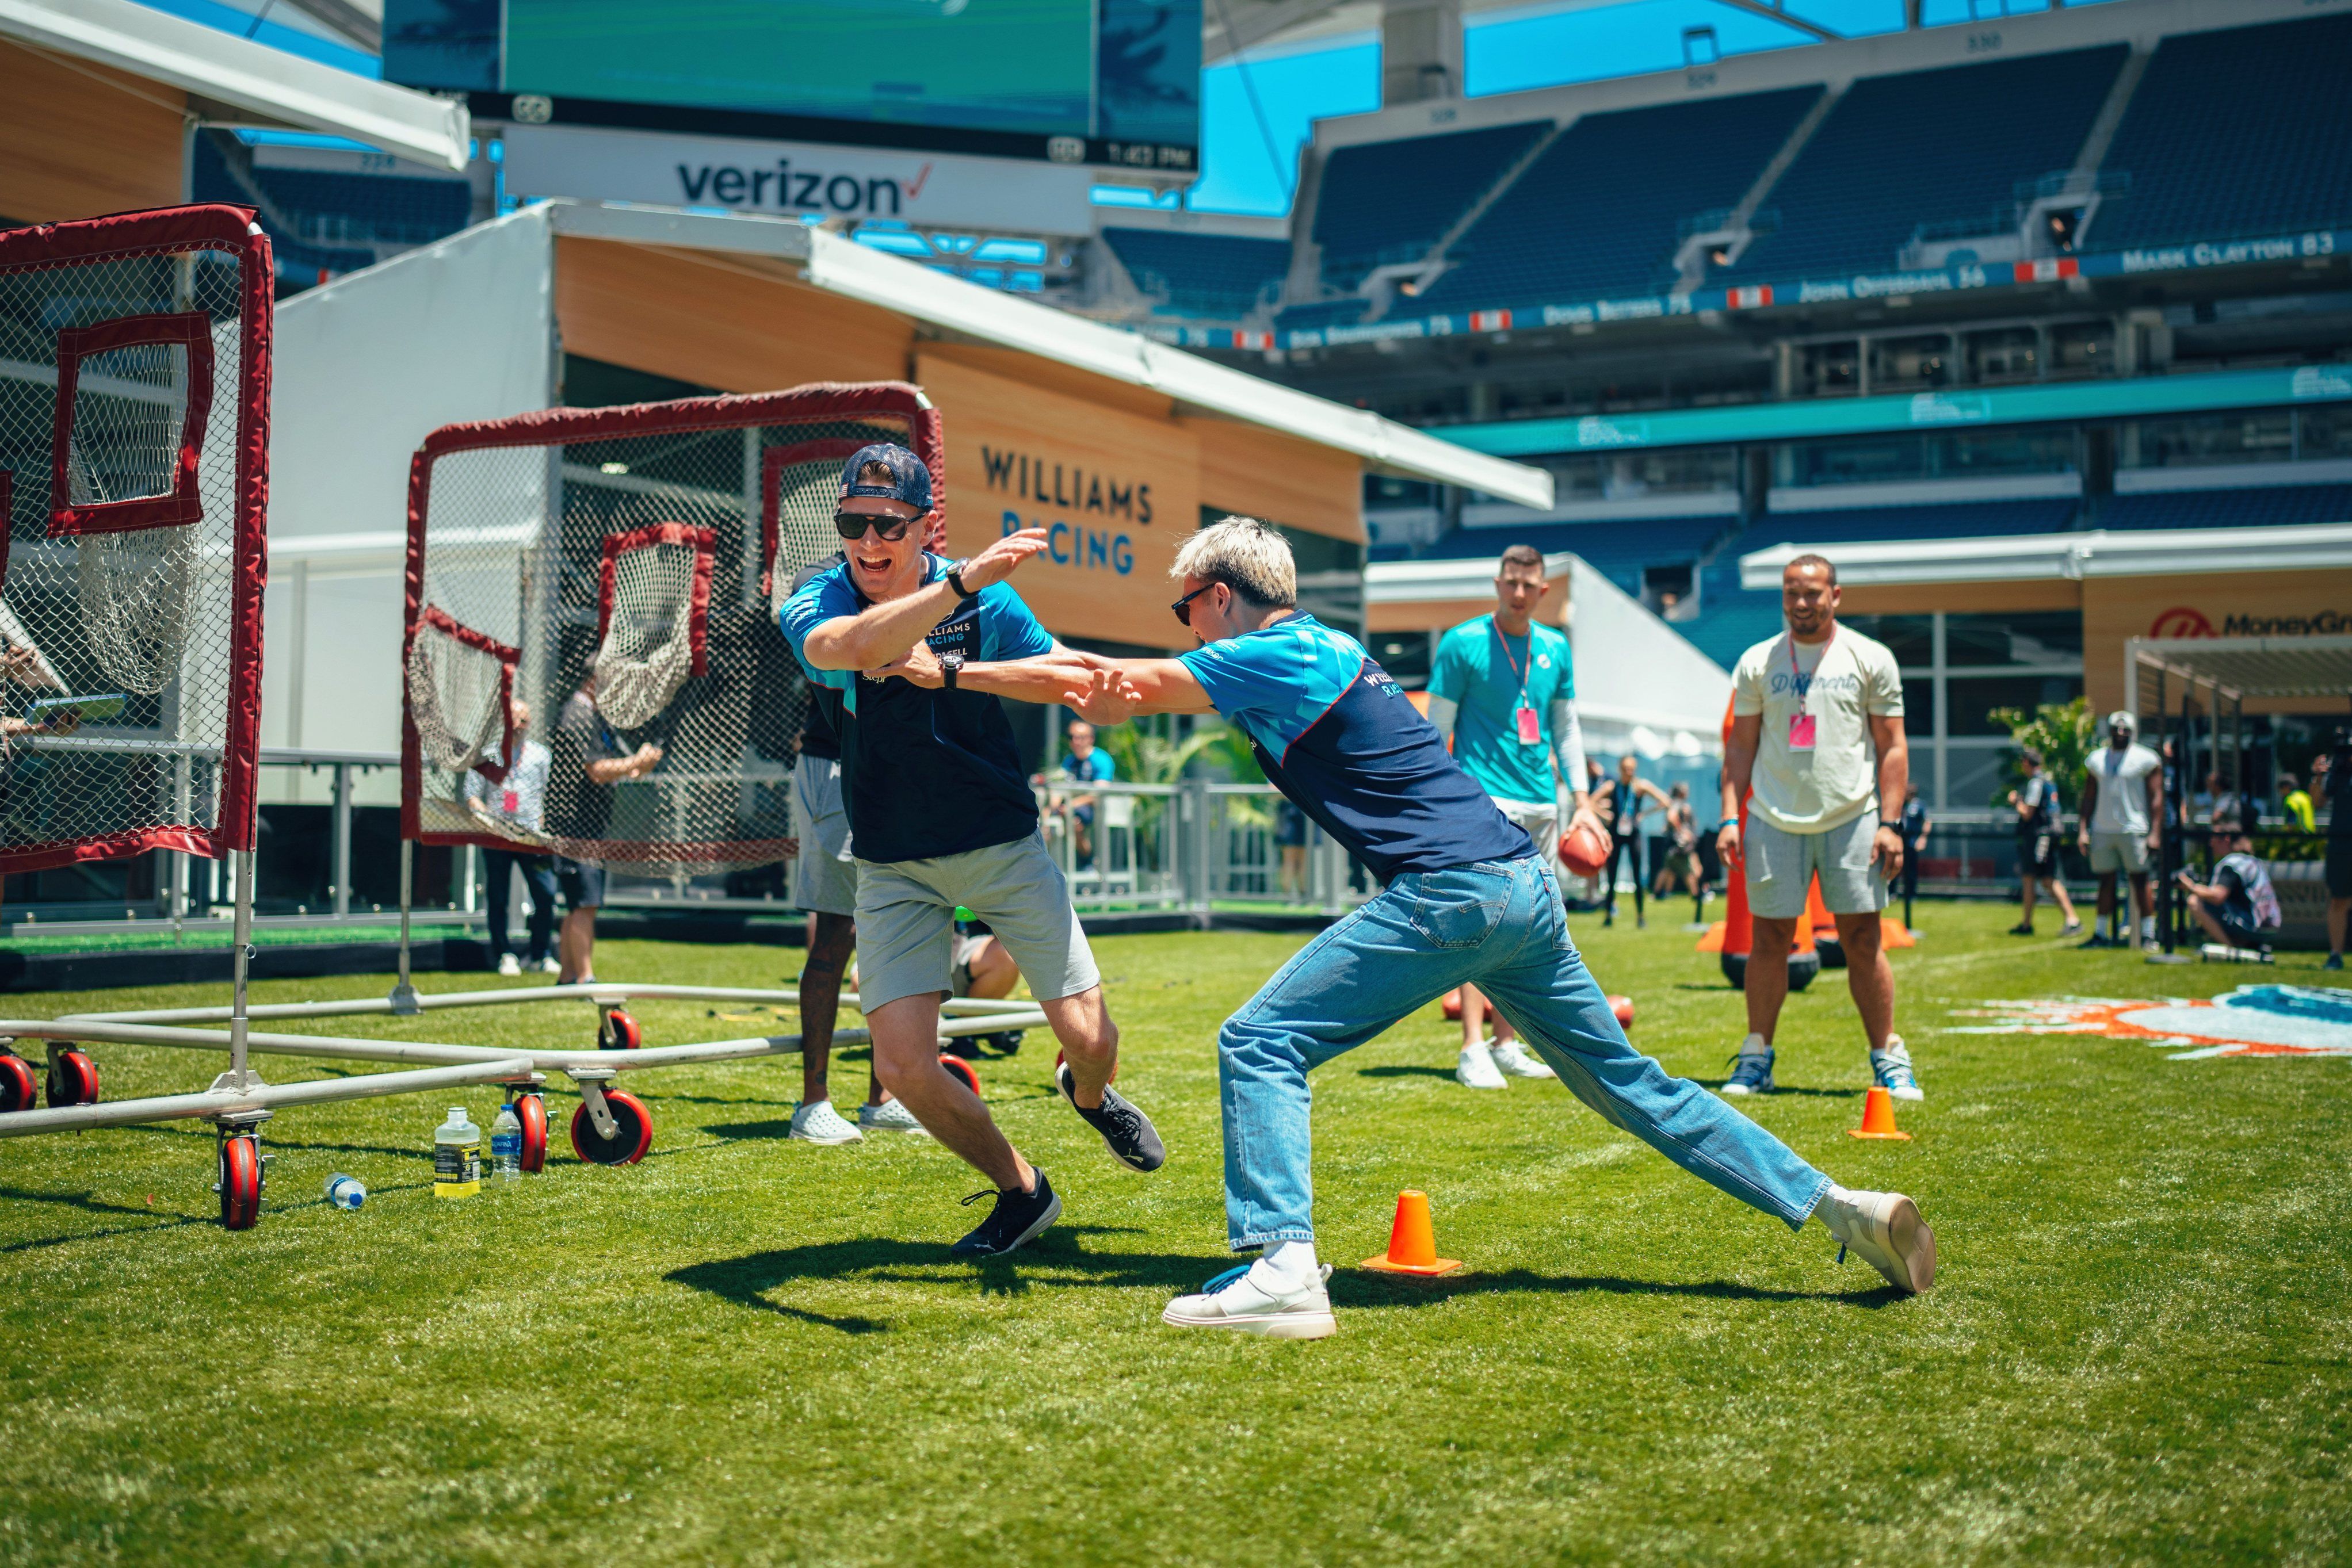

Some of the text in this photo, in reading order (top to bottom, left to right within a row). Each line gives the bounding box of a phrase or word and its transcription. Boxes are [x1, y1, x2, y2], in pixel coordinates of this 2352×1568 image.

[677, 158, 902, 215] verizon
[982, 446, 1154, 525] WILLIAMS
[925, 633, 964, 646] ACING
[929, 622, 971, 637] LLIAMS
